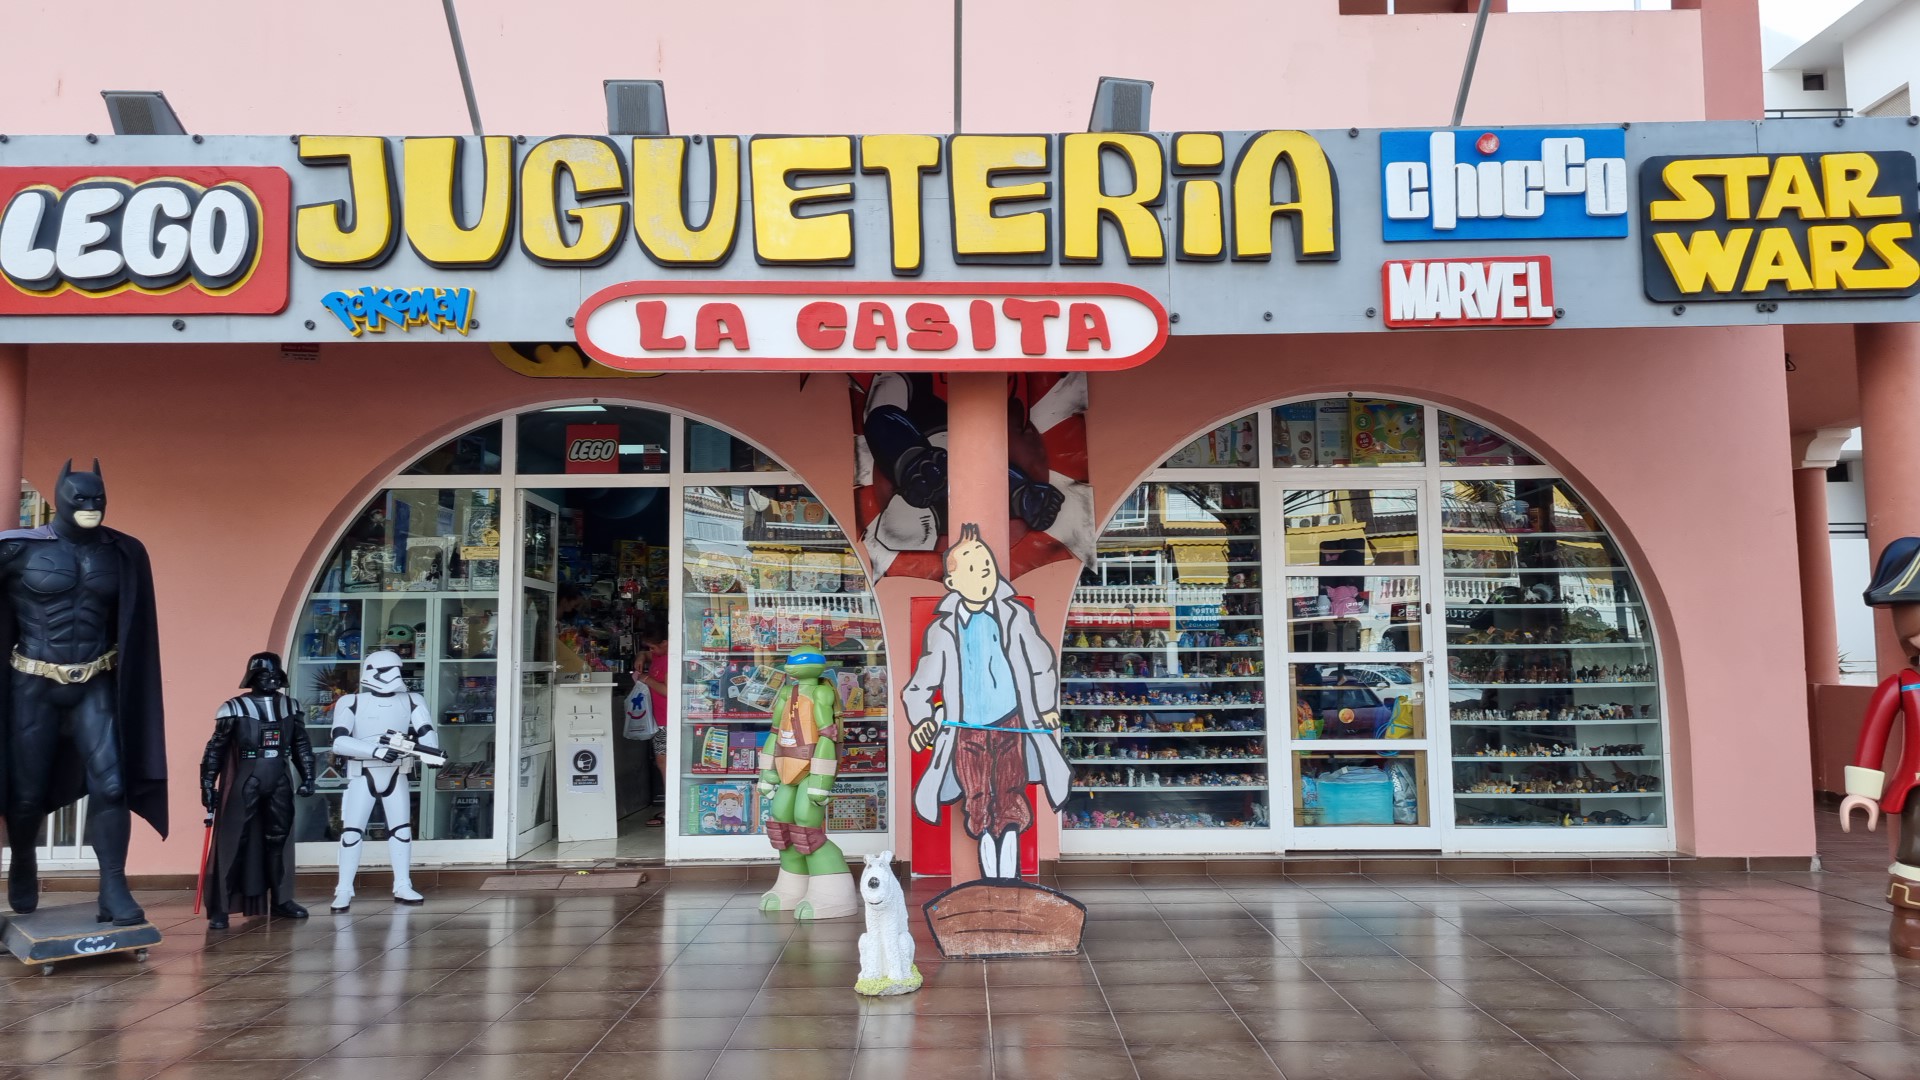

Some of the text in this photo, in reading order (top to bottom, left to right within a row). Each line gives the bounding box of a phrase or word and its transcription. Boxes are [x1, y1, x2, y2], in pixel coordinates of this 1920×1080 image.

[296, 130, 1338, 276] JUGUETERIA
[1385, 131, 1628, 230] chicco
[1650, 152, 1902, 221] STAR
[0, 184, 252, 284] LEGO
[1652, 222, 1920, 294] WARS
[636, 297, 1112, 355] LA CASITA
[1389, 261, 1554, 321] MARVEL
[568, 440, 617, 461] LEGO
